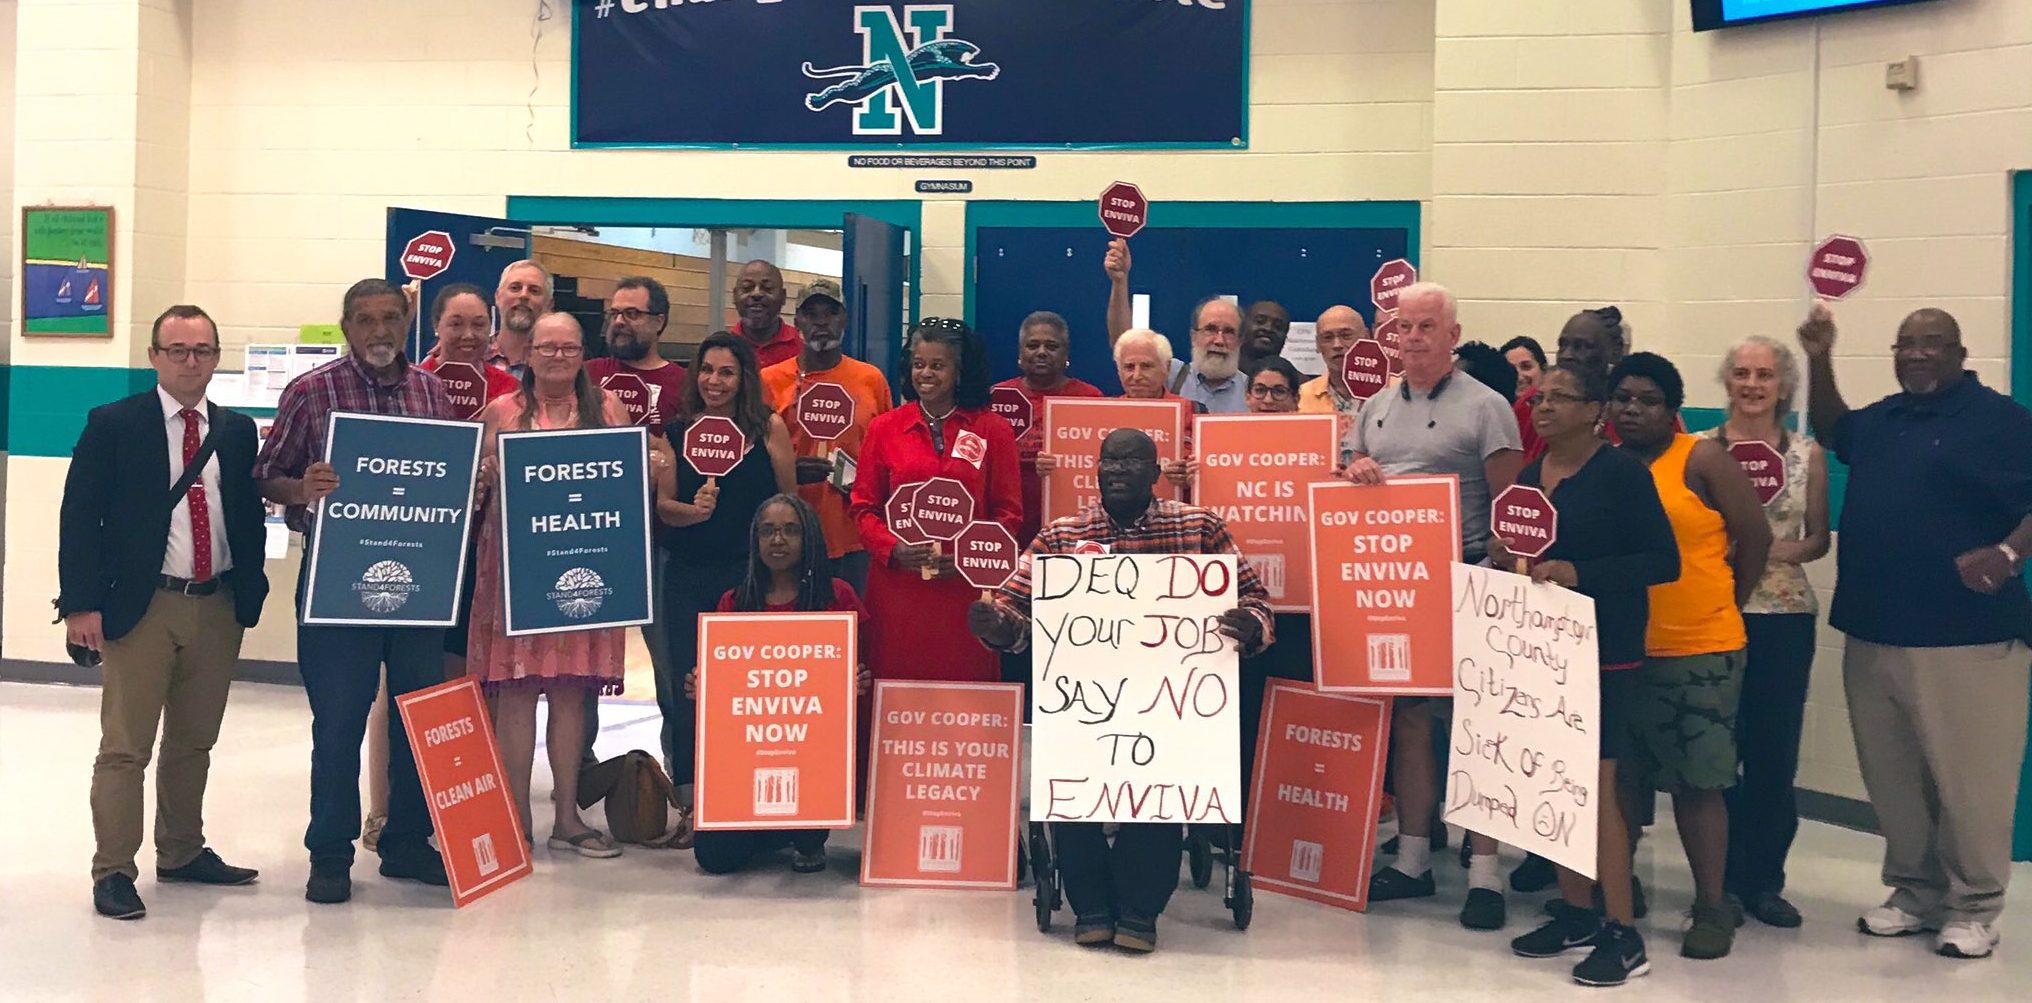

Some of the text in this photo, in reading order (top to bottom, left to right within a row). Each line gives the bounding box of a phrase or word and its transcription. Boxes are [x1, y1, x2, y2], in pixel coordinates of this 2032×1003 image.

[854, 158, 1031, 166] NO FOOD OR BEVERAGES BEYOND THIS POINT
[920, 182, 968, 190] GYMNASIUM
[1111, 197, 1136, 208] STOP
[1104, 210, 1140, 224] ENVIVA
[418, 244, 443, 254] STOP
[407, 254, 442, 268] ENVIVA
[1382, 273, 1406, 286] STOP
[1354, 356, 1378, 368] STOP
[443, 379, 472, 390] TOP
[1348, 370, 1382, 384] ENVIVA
[446, 394, 478, 406] VIVA
[812, 399, 841, 410] STOP
[991, 404, 1020, 413] STOP
[804, 412, 846, 424] ENVIVA
[700, 433, 730, 444] STOP
[1056, 426, 1092, 440] GOV
[691, 448, 736, 460] ENVIVA
[1053, 454, 1094, 468] THIS
[1206, 452, 1326, 467] GOV COOPER:
[356, 456, 447, 478] FORESTS
[525, 460, 624, 483] FORESTS
[1740, 460, 1768, 470] TOP
[1237, 480, 1295, 498] NC IS
[928, 494, 960, 508] STOP
[328, 502, 462, 524] COMMUNITY
[918, 510, 964, 525] ENVIVA
[1320, 508, 1445, 526] GOV COOPER:
[1507, 504, 1541, 520] STOP
[531, 510, 621, 534] HEALTH
[1500, 520, 1548, 539] ENVIVA
[360, 538, 423, 548] #Stand4Forests
[970, 540, 1002, 552] STOP
[1354, 534, 1413, 554] STOP
[962, 556, 1010, 570] ENVIVA
[1341, 560, 1430, 582] ENVIVA
[352, 582, 421, 592] STAND4FORESTS
[1034, 555, 1230, 602] DEQ DO
[1356, 589, 1416, 608] NOW
[1140, 614, 1224, 664] JOB
[714, 644, 842, 660] GOV COOPER:
[1486, 625, 1568, 686] County
[746, 669, 808, 689] STOP
[1038, 666, 1228, 724] SAY NO
[732, 696, 824, 716] ENVIVA
[887, 710, 1008, 728] GOV COOPER:
[424, 716, 474, 748] FORESTS
[746, 724, 808, 743] NOW
[1285, 724, 1363, 752] FORESTS
[882, 740, 1010, 758] THIS IS YOUR
[1096, 732, 1155, 766] TO
[902, 762, 988, 780] CLIMATE
[436, 773, 497, 810] CLEAN AIR
[906, 784, 981, 802] LEGACY
[1046, 776, 1232, 824] ENVIVA
[1278, 783, 1350, 812] HEALTH
[1445, 769, 1520, 830] Dumped
